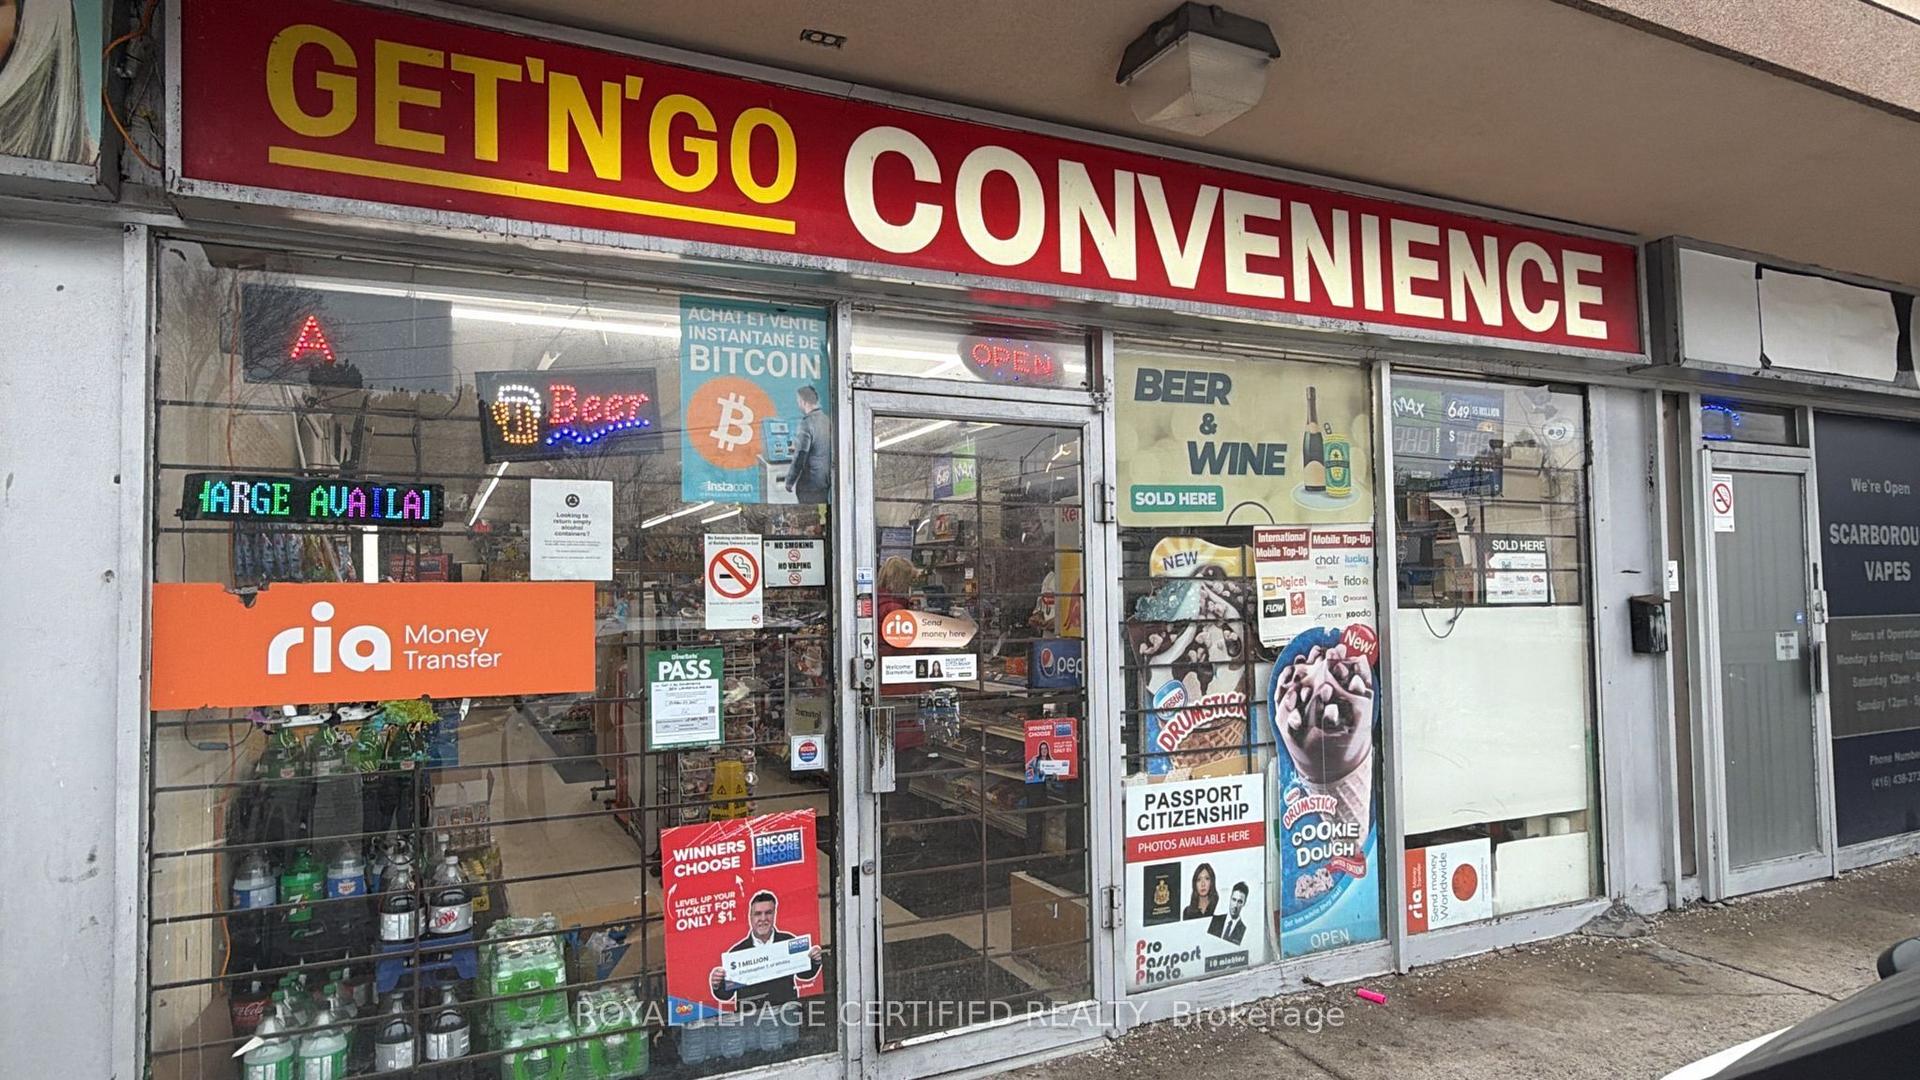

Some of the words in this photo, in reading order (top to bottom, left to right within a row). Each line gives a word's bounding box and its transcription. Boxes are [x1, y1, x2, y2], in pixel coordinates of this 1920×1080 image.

[843, 126, 1607, 340] CONVENIENCE
[688, 307, 742, 324] ACHAT
[747, 313, 764, 326] ET
[770, 314, 819, 332] VENTE
[290, 315, 334, 361] A
[688, 325, 795, 348] INSTANTANÉ
[799, 336, 819, 350] DE
[690, 344, 822, 380] BITCOIN
[972, 343, 1053, 377] OPEN
[1134, 367, 1232, 405] BEER
[549, 384, 649, 424] Beer
[1392, 396, 1425, 419] MAX
[1448, 400, 1470, 419] 649
[1199, 413, 1217, 435] &
[1187, 441, 1288, 476] WINE
[1851, 477, 1881, 494] We're
[1883, 480, 1911, 497] Open
[1135, 492, 1176, 506] SOLD
[1179, 492, 1217, 505] HERE
[556, 512, 581, 520] Looking
[774, 541, 784, 549] NO
[784, 541, 814, 549] SMOKING
[1258, 531, 1306, 542] International
[1313, 534, 1341, 545] Mobile
[1342, 534, 1371, 545] Top-Up
[1491, 540, 1518, 551] SOLD
[1520, 540, 1546, 551] HERE
[1162, 550, 1199, 571] NEW
[1256, 547, 1281, 558] Mobile
[1282, 546, 1308, 557] Top-Up
[1344, 554, 1369, 565] lucky
[778, 562, 788, 570] NO
[788, 561, 812, 570] VAPING
[1865, 561, 1912, 582] VAPES
[1276, 576, 1307, 590] Digicel
[1344, 575, 1361, 586] fido
[1265, 603, 1285, 613] FLOW
[1321, 595, 1337, 606] Bell
[886, 614, 914, 634] ria
[921, 618, 942, 626] Send
[267, 601, 392, 675] ria
[404, 624, 490, 648] Money
[921, 631, 948, 639] money
[948, 629, 967, 638] here
[1343, 631, 1376, 655] New!
[1850, 630, 1875, 641] Hours
[403, 648, 502, 672] Transfer
[1836, 653, 1868, 666] Monday
[1870, 652, 1879, 664] to
[1879, 651, 1904, 664] Friday
[658, 659, 712, 681] PASS
[1852, 676, 1888, 688] Saturday
[1856, 700, 1886, 712] Sunday
[1158, 693, 1248, 752] DRUMSTICK
[1869, 755, 1893, 766] Phone
[1871, 775, 1892, 789] (416)
[1145, 784, 1242, 811] PASSPORT
[1137, 803, 1249, 831] CITIZENSHIP
[1283, 796, 1337, 829] DRUMSTICK
[756, 832, 800, 847] ENCORE
[1138, 839, 1177, 853] PHOTOS
[1178, 833, 1226, 848] AVAILABLE
[1227, 830, 1250, 841] HERE
[1291, 821, 1360, 847] COOKIE
[673, 840, 746, 862] WINNERS
[756, 843, 800, 856] ENCORE
[757, 850, 800, 865] ENCORE
[1296, 842, 1355, 868] DOUGH
[674, 856, 741, 878] CHOOSE
[1430, 854, 1438, 891] money
[1439, 852, 1449, 921] Worldwide
[675, 898, 699, 908] LEVEL
[700, 895, 712, 904] UP
[713, 891, 736, 901] YOUR
[675, 903, 713, 918] TICKET
[714, 901, 737, 911] FOR
[1408, 889, 1423, 919] ria
[1430, 893, 1439, 922] Send
[676, 914, 714, 931] ONLY
[717, 911, 737, 925] $1.
[1136, 940, 1162, 955] Pro
[1310, 928, 1350, 948] OPEN
[730, 961, 737, 970] $
[742, 955, 769, 967] MILLION
[1136, 945, 1201, 970] Passport
[1136, 966, 1181, 985] Photo
